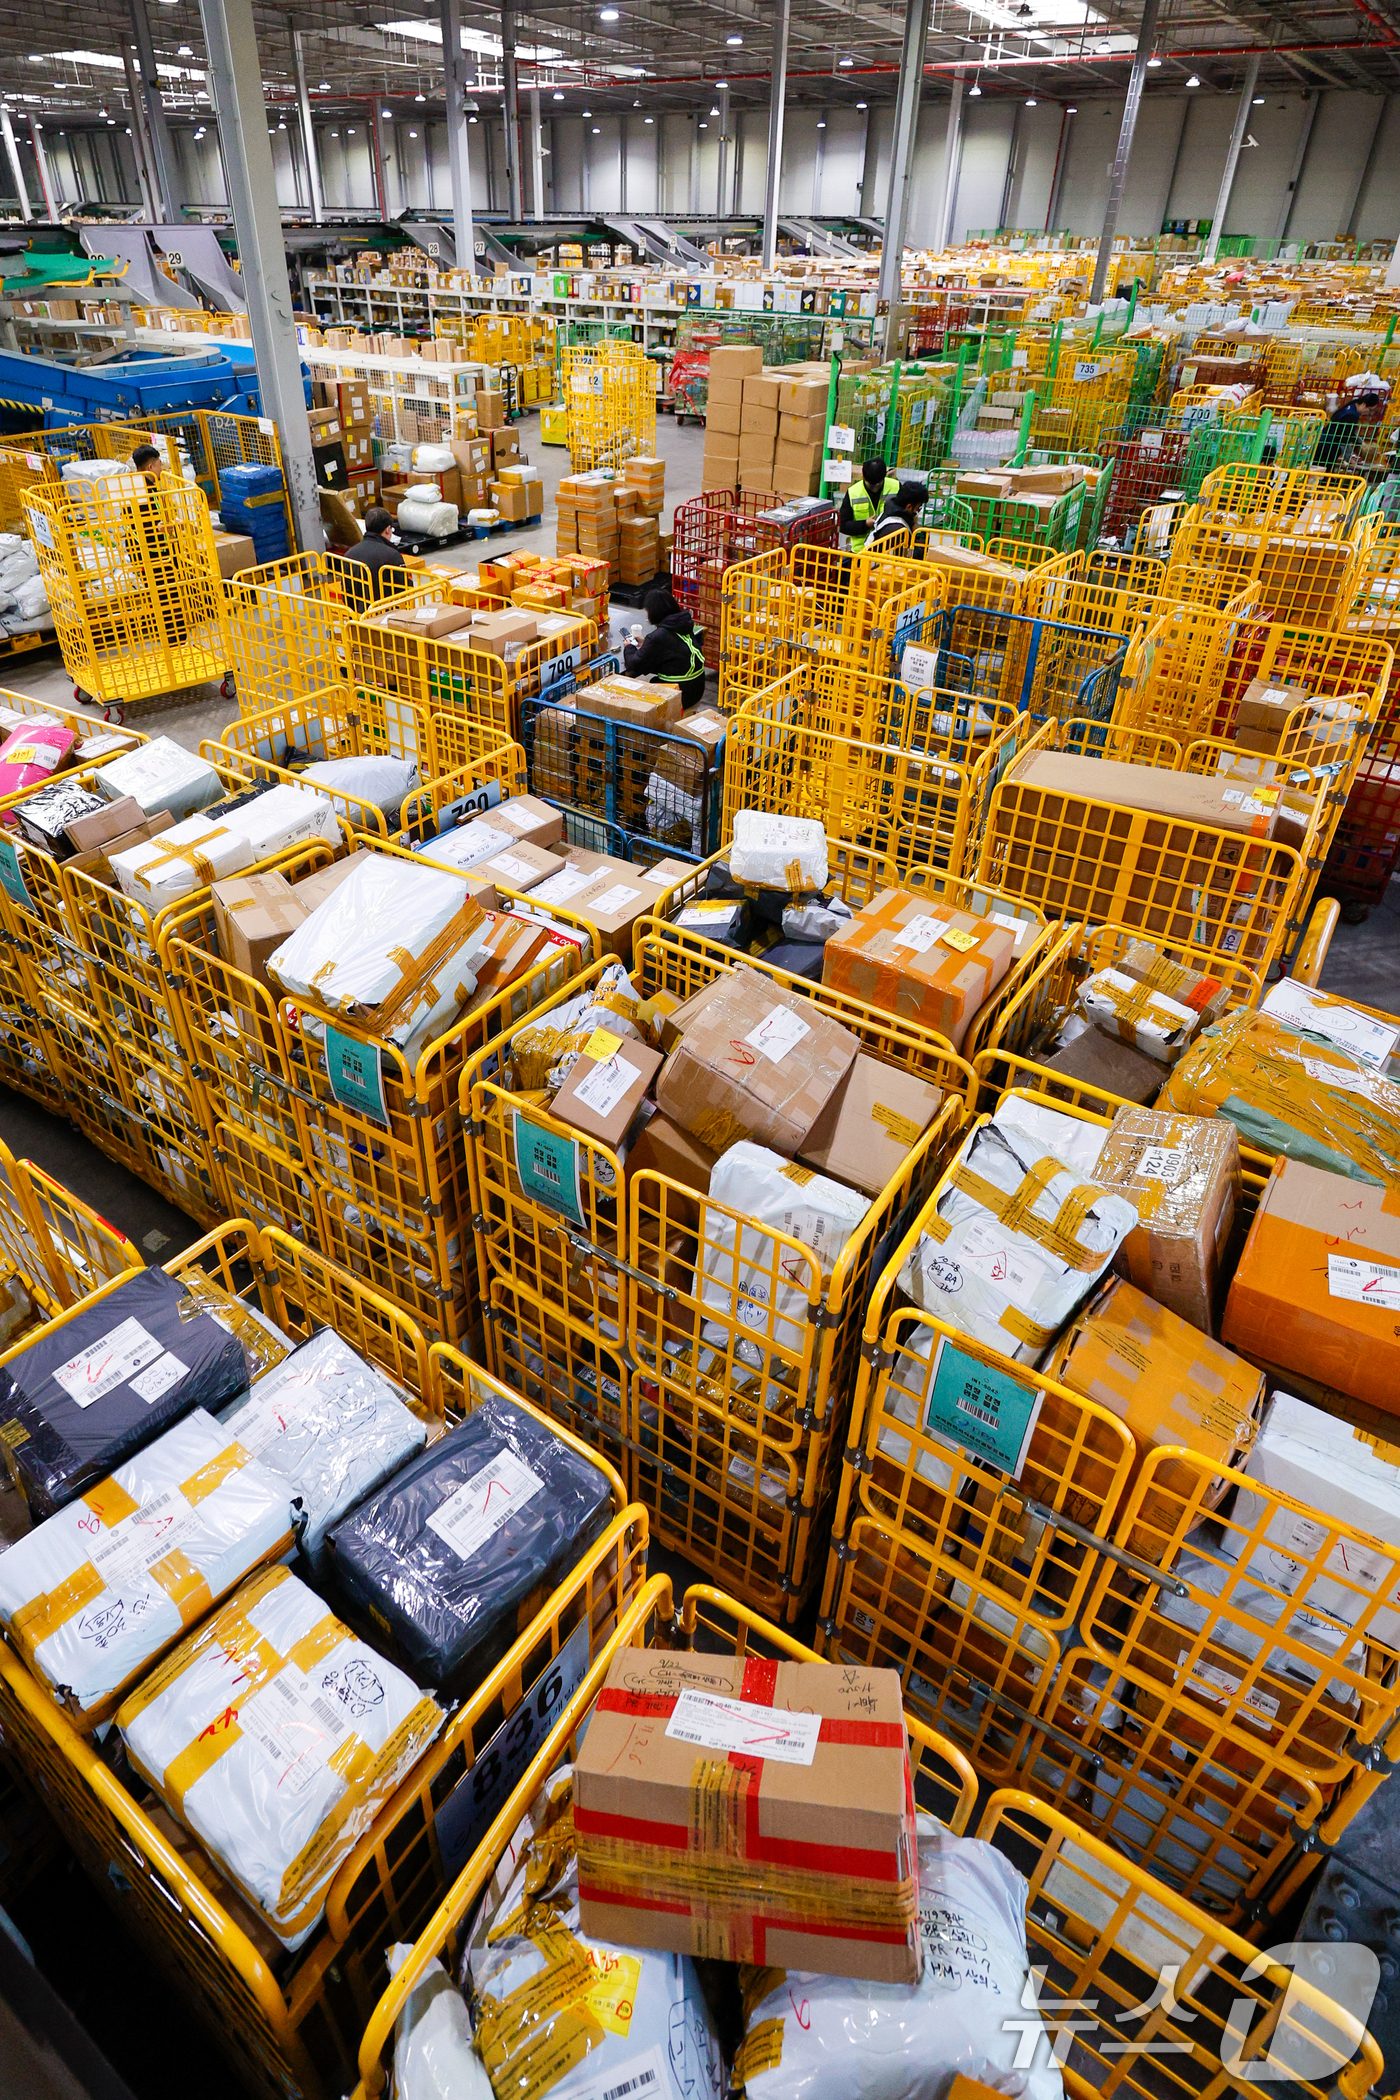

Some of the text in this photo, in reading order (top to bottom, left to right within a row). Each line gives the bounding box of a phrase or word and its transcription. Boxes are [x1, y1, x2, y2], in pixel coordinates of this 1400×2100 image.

[429, 244, 439, 254] 28
[476, 243, 484, 251] 27
[169, 253, 182, 265] 29
[1080, 365, 1095, 374] 735
[1191, 409, 1210, 420] 700
[903, 608, 920, 629] 713
[549, 655, 573, 682] 799
[1145, 1150, 1163, 1175] #124
[1163, 1153, 1181, 1178] 0903
[965, 1382, 1000, 1406] 현장 감정
[971, 1425, 997, 1444] TIPA
[659, 1659, 682, 1669] 9/22
[473, 1665, 563, 1804] 836
